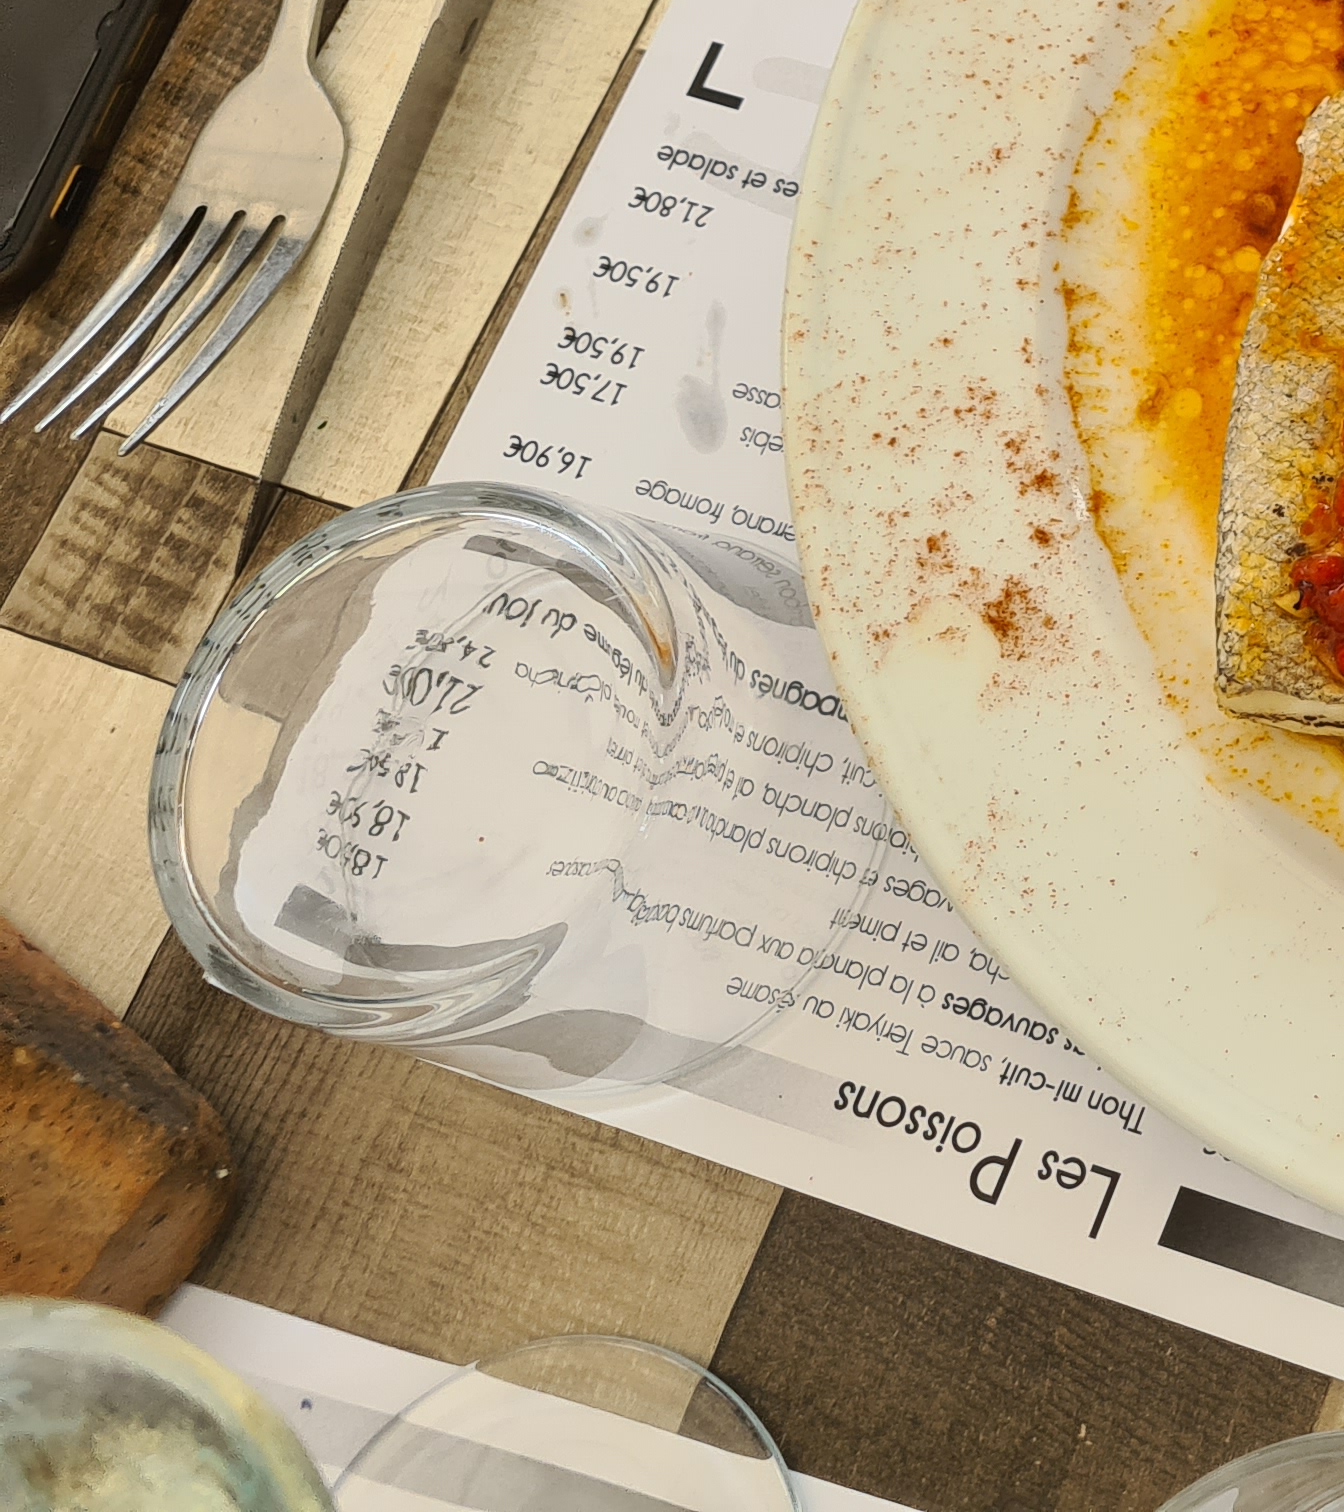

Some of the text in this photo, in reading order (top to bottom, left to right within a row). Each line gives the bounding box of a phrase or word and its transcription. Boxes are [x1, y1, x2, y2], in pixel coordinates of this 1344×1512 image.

[657, 145, 739, 180] salade
[628, 186, 714, 228] 21,80€
[593, 255, 680, 297] 19,50€
[557, 326, 645, 369] 19,50€
[540, 362, 627, 406] 17,50€
[503, 435, 592, 479] 16,90€
[635, 479, 725, 524] fromage
[762, 783, 859, 832] plancha,
[766, 837, 857, 885] chipirons
[928, 940, 960, 964] ail
[941, 993, 1059, 1045] sauvages
[836, 1007, 1145, 1135] Thon mi-cuit, sauce Teriyaki
[834, 1081, 1121, 1239] Les Poissons
